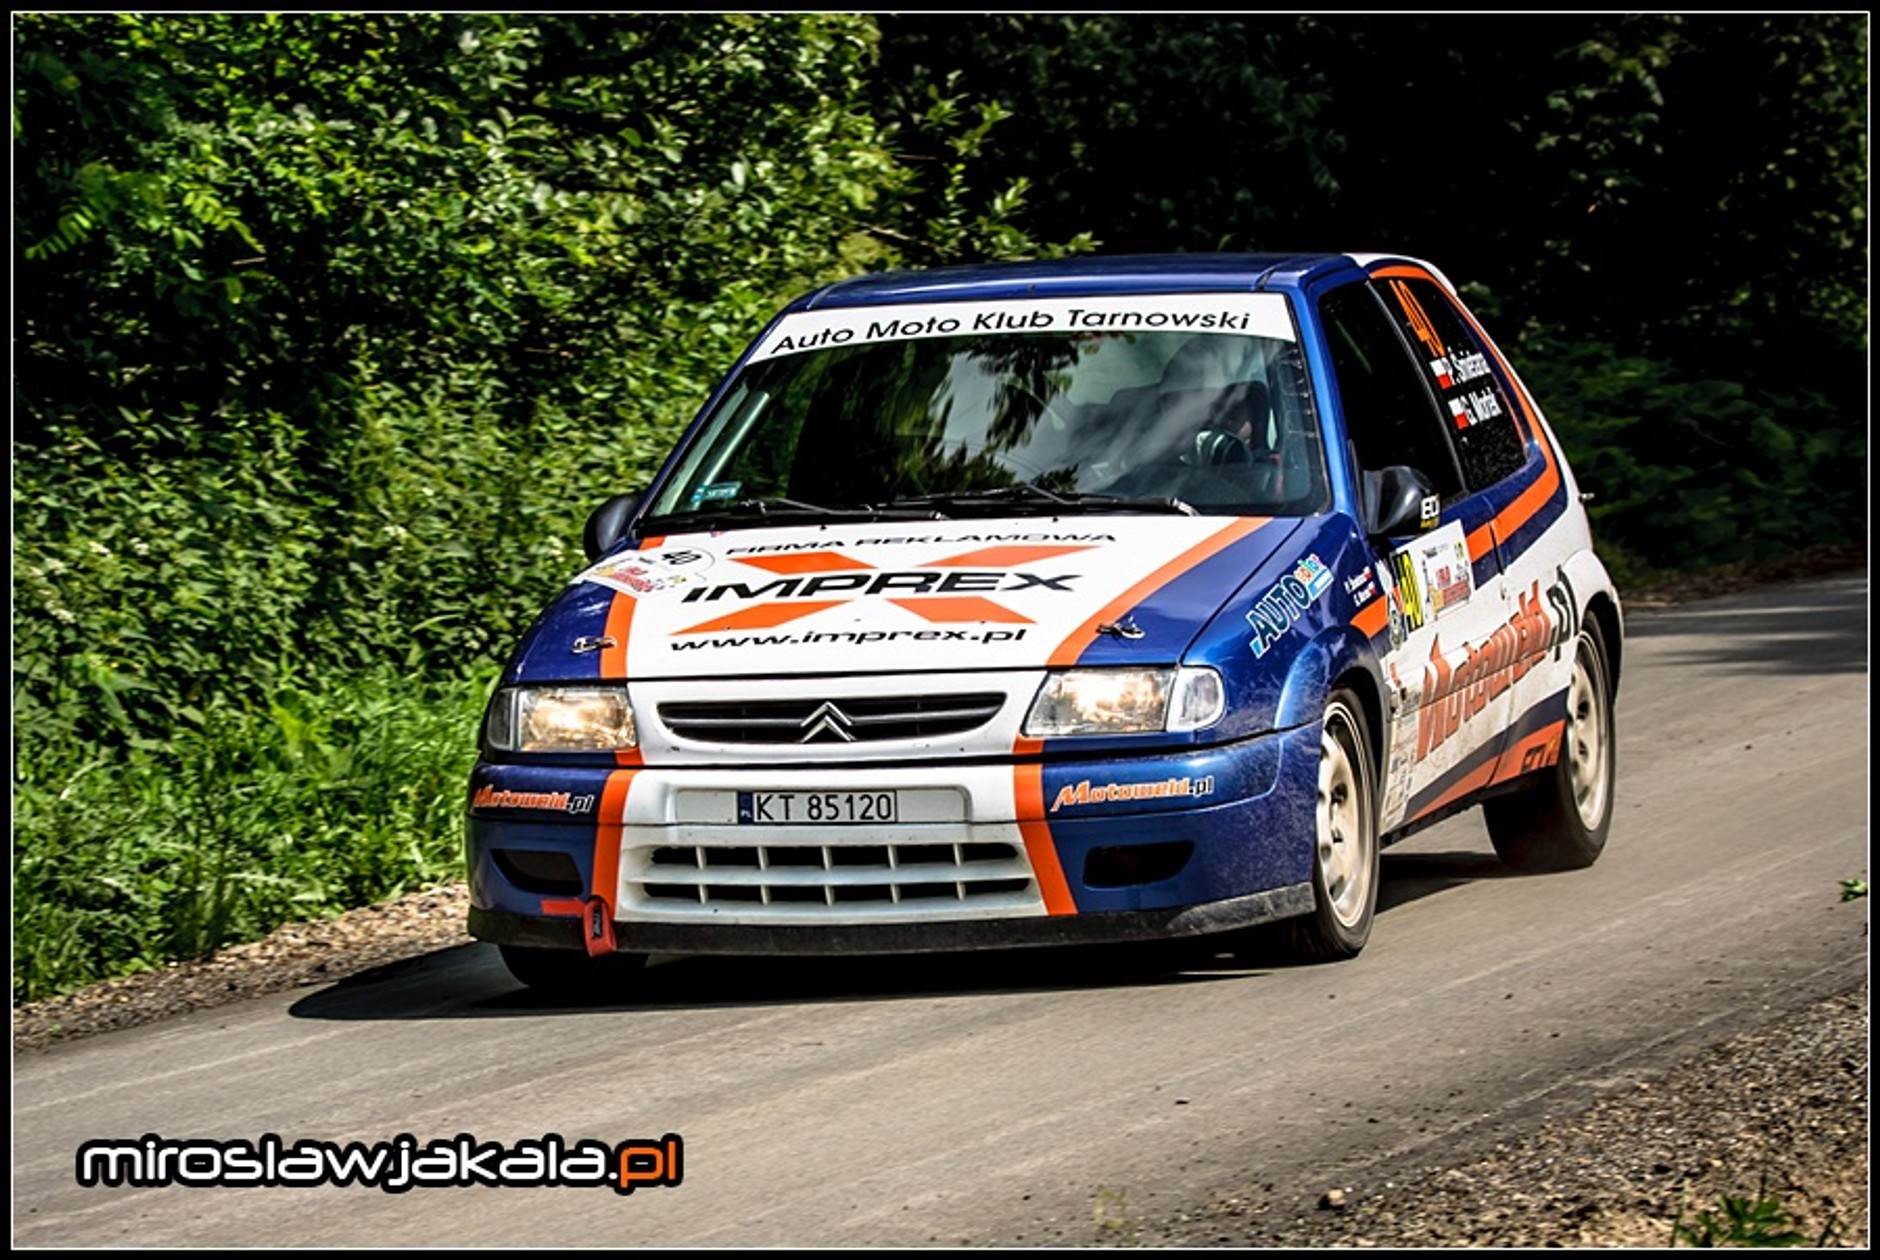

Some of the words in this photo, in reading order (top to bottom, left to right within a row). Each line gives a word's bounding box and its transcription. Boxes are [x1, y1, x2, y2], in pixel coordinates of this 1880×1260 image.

[770, 328, 854, 355] Auto
[865, 316, 961, 340] Moto
[972, 311, 1055, 329] Klub
[1067, 308, 1251, 330] Tarnowski
[1387, 278, 1447, 358] 40
[725, 538, 845, 555] FIRMA
[855, 533, 1117, 547] REKLAMOWA
[681, 571, 1085, 604] IMPREX
[1245, 575, 1311, 651] AUTO
[670, 628, 1027, 652] www.imprex.pl
[469, 783, 595, 815] Motoweld.pl
[756, 794, 796, 821] KT
[807, 793, 892, 821] 85120
[1050, 775, 1215, 812] Motoweld.pl
